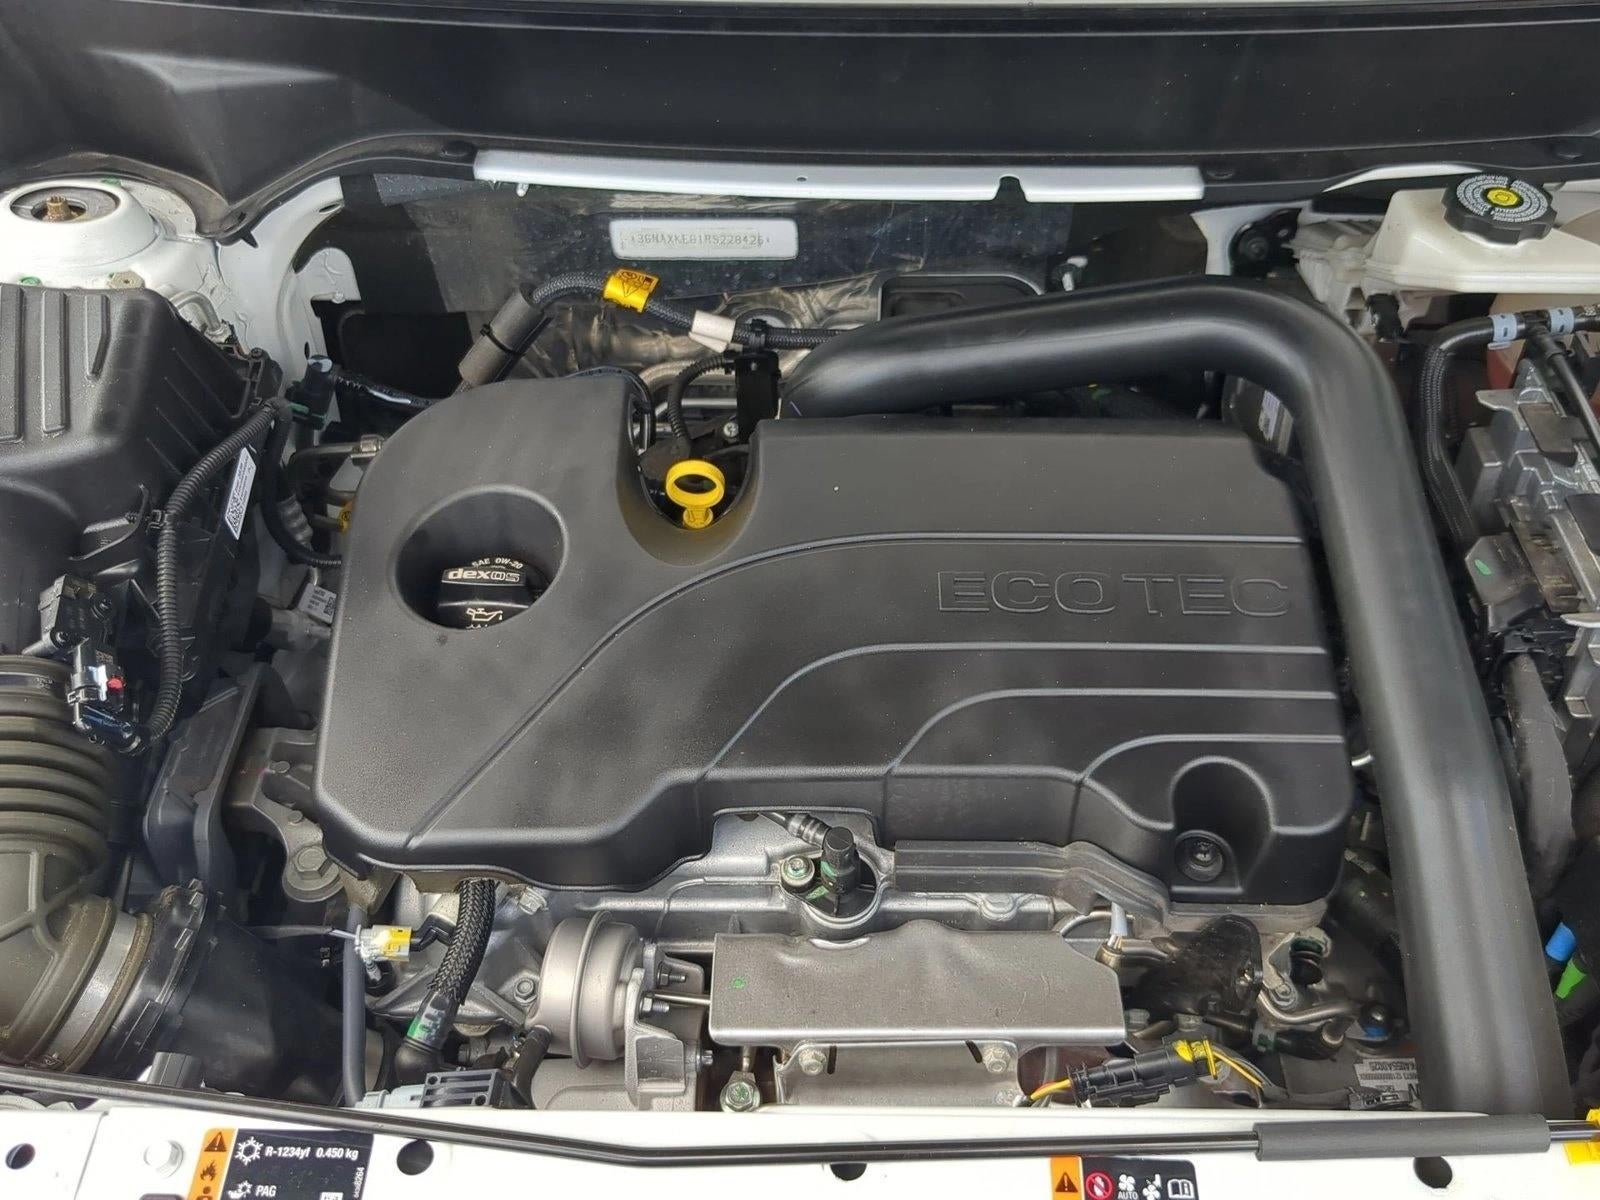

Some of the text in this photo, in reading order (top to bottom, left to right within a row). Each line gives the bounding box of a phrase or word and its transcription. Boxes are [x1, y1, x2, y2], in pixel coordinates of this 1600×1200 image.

[472, 557, 524, 570] SAE 0W-20
[448, 568, 520, 582] dexos
[937, 571, 1290, 617] ECOTEC
[265, 1146, 359, 1161] R-1234yf 0.450 kg
[255, 1185, 277, 1198] PAG
[1117, 1191, 1138, 1200] AUTO
